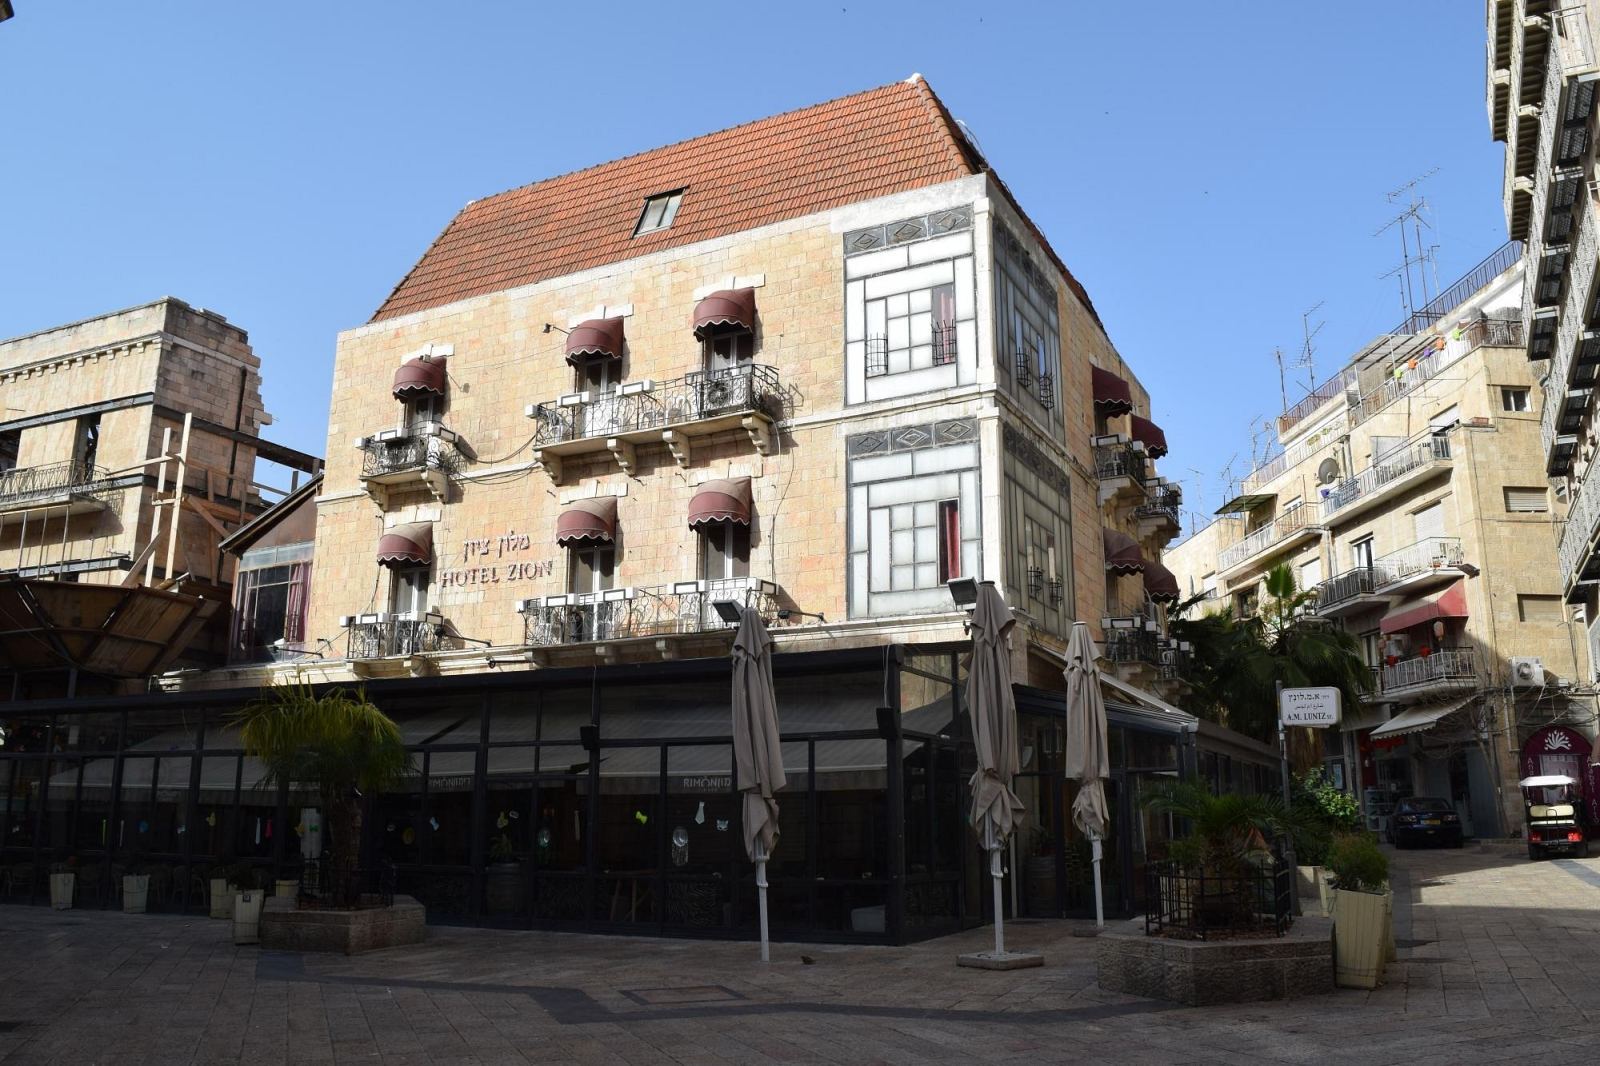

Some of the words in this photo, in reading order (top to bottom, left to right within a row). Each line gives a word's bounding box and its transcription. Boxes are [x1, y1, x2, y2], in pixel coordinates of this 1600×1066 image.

[464, 538, 490, 563] ציון
[497, 530, 530, 558] מלון
[441, 566, 500, 588] HOTEL
[507, 560, 553, 582] ZION
[1287, 713, 1303, 721] A.M.
[1304, 712, 1326, 720] LUNTZ
[683, 776, 716, 788] RIMON
